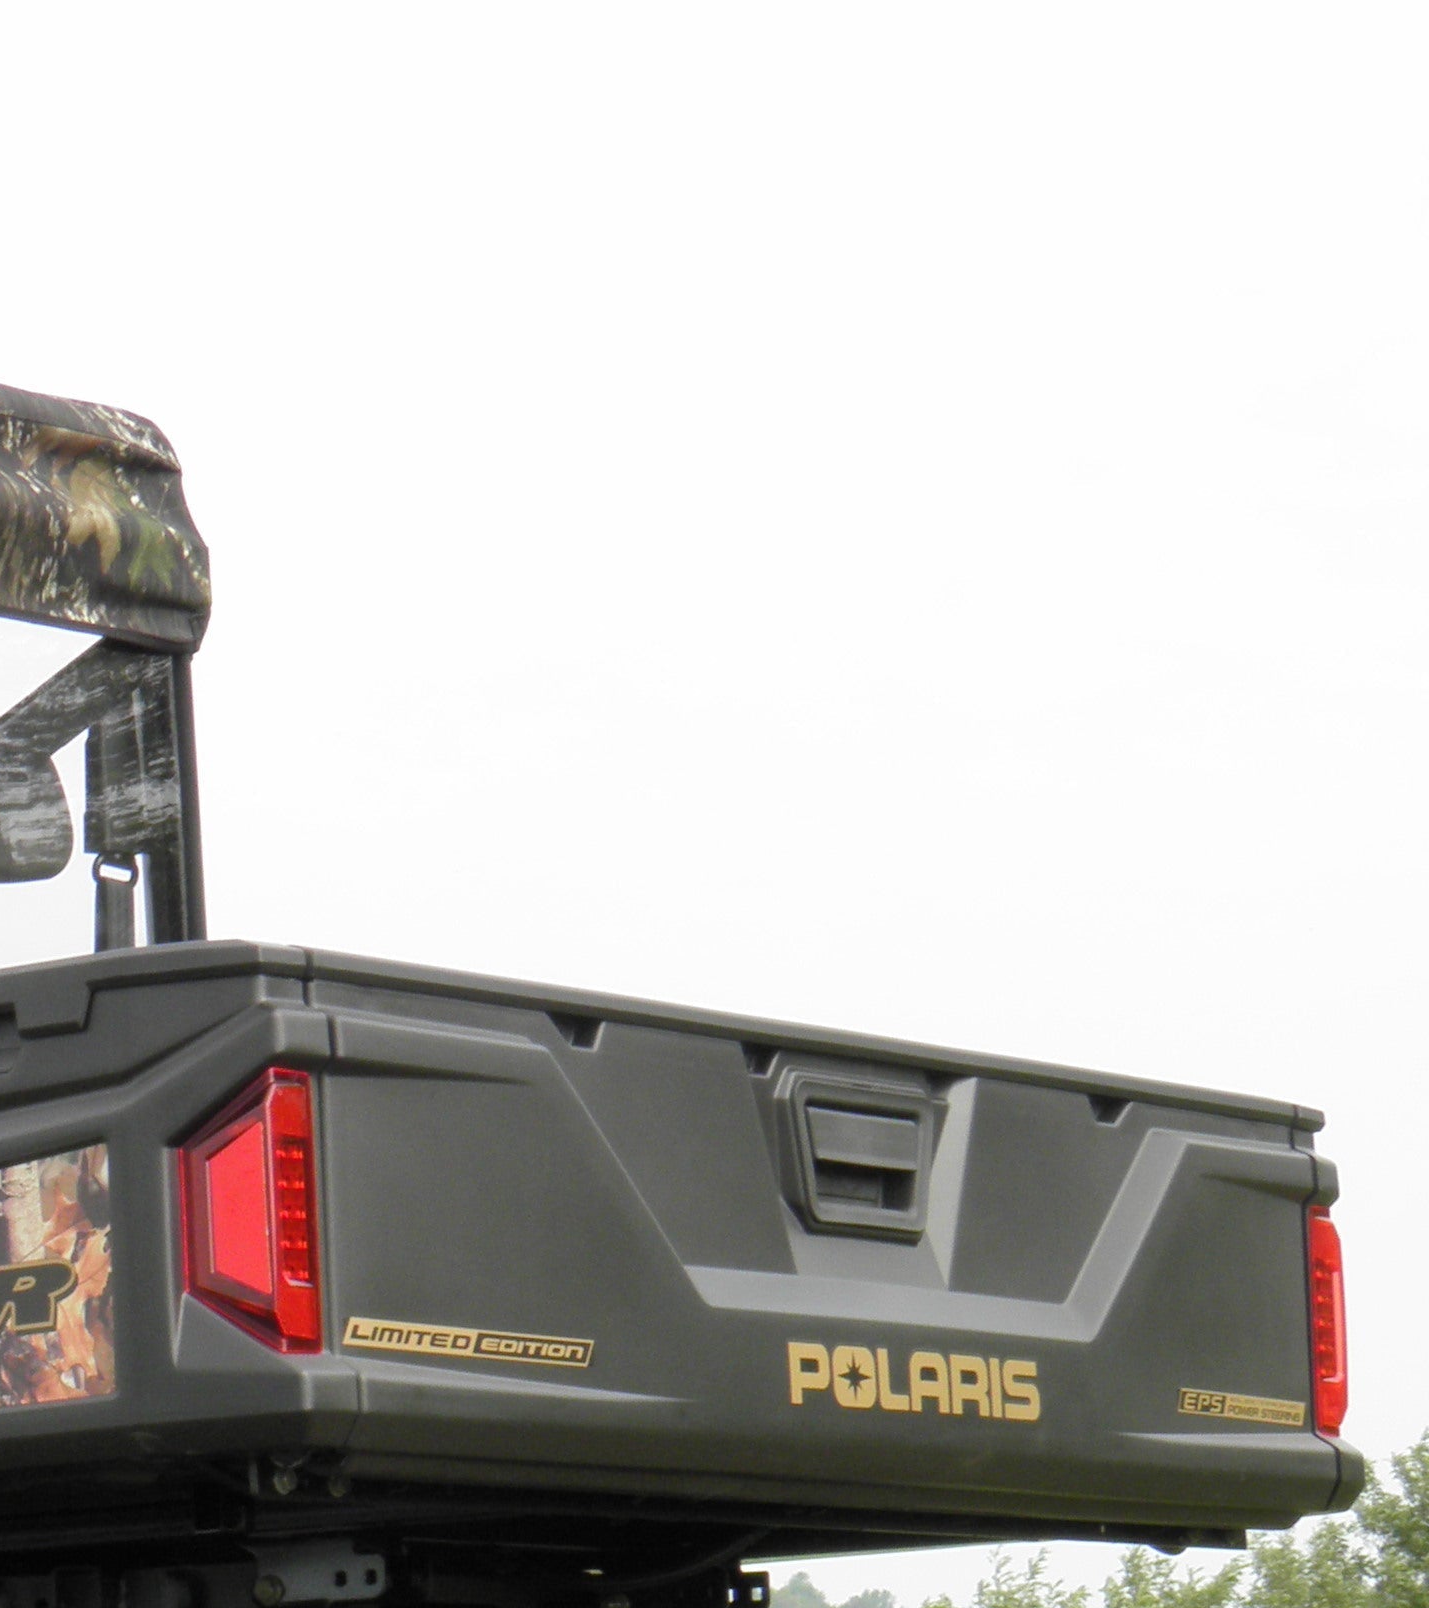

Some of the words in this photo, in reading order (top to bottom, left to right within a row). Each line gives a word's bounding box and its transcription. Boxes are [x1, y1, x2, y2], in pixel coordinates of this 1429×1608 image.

[350, 1324, 471, 1350] LIMITED
[480, 1336, 584, 1360] EDITION
[787, 1341, 1040, 1421] POLARIS
[1183, 1392, 1224, 1414] EPS
